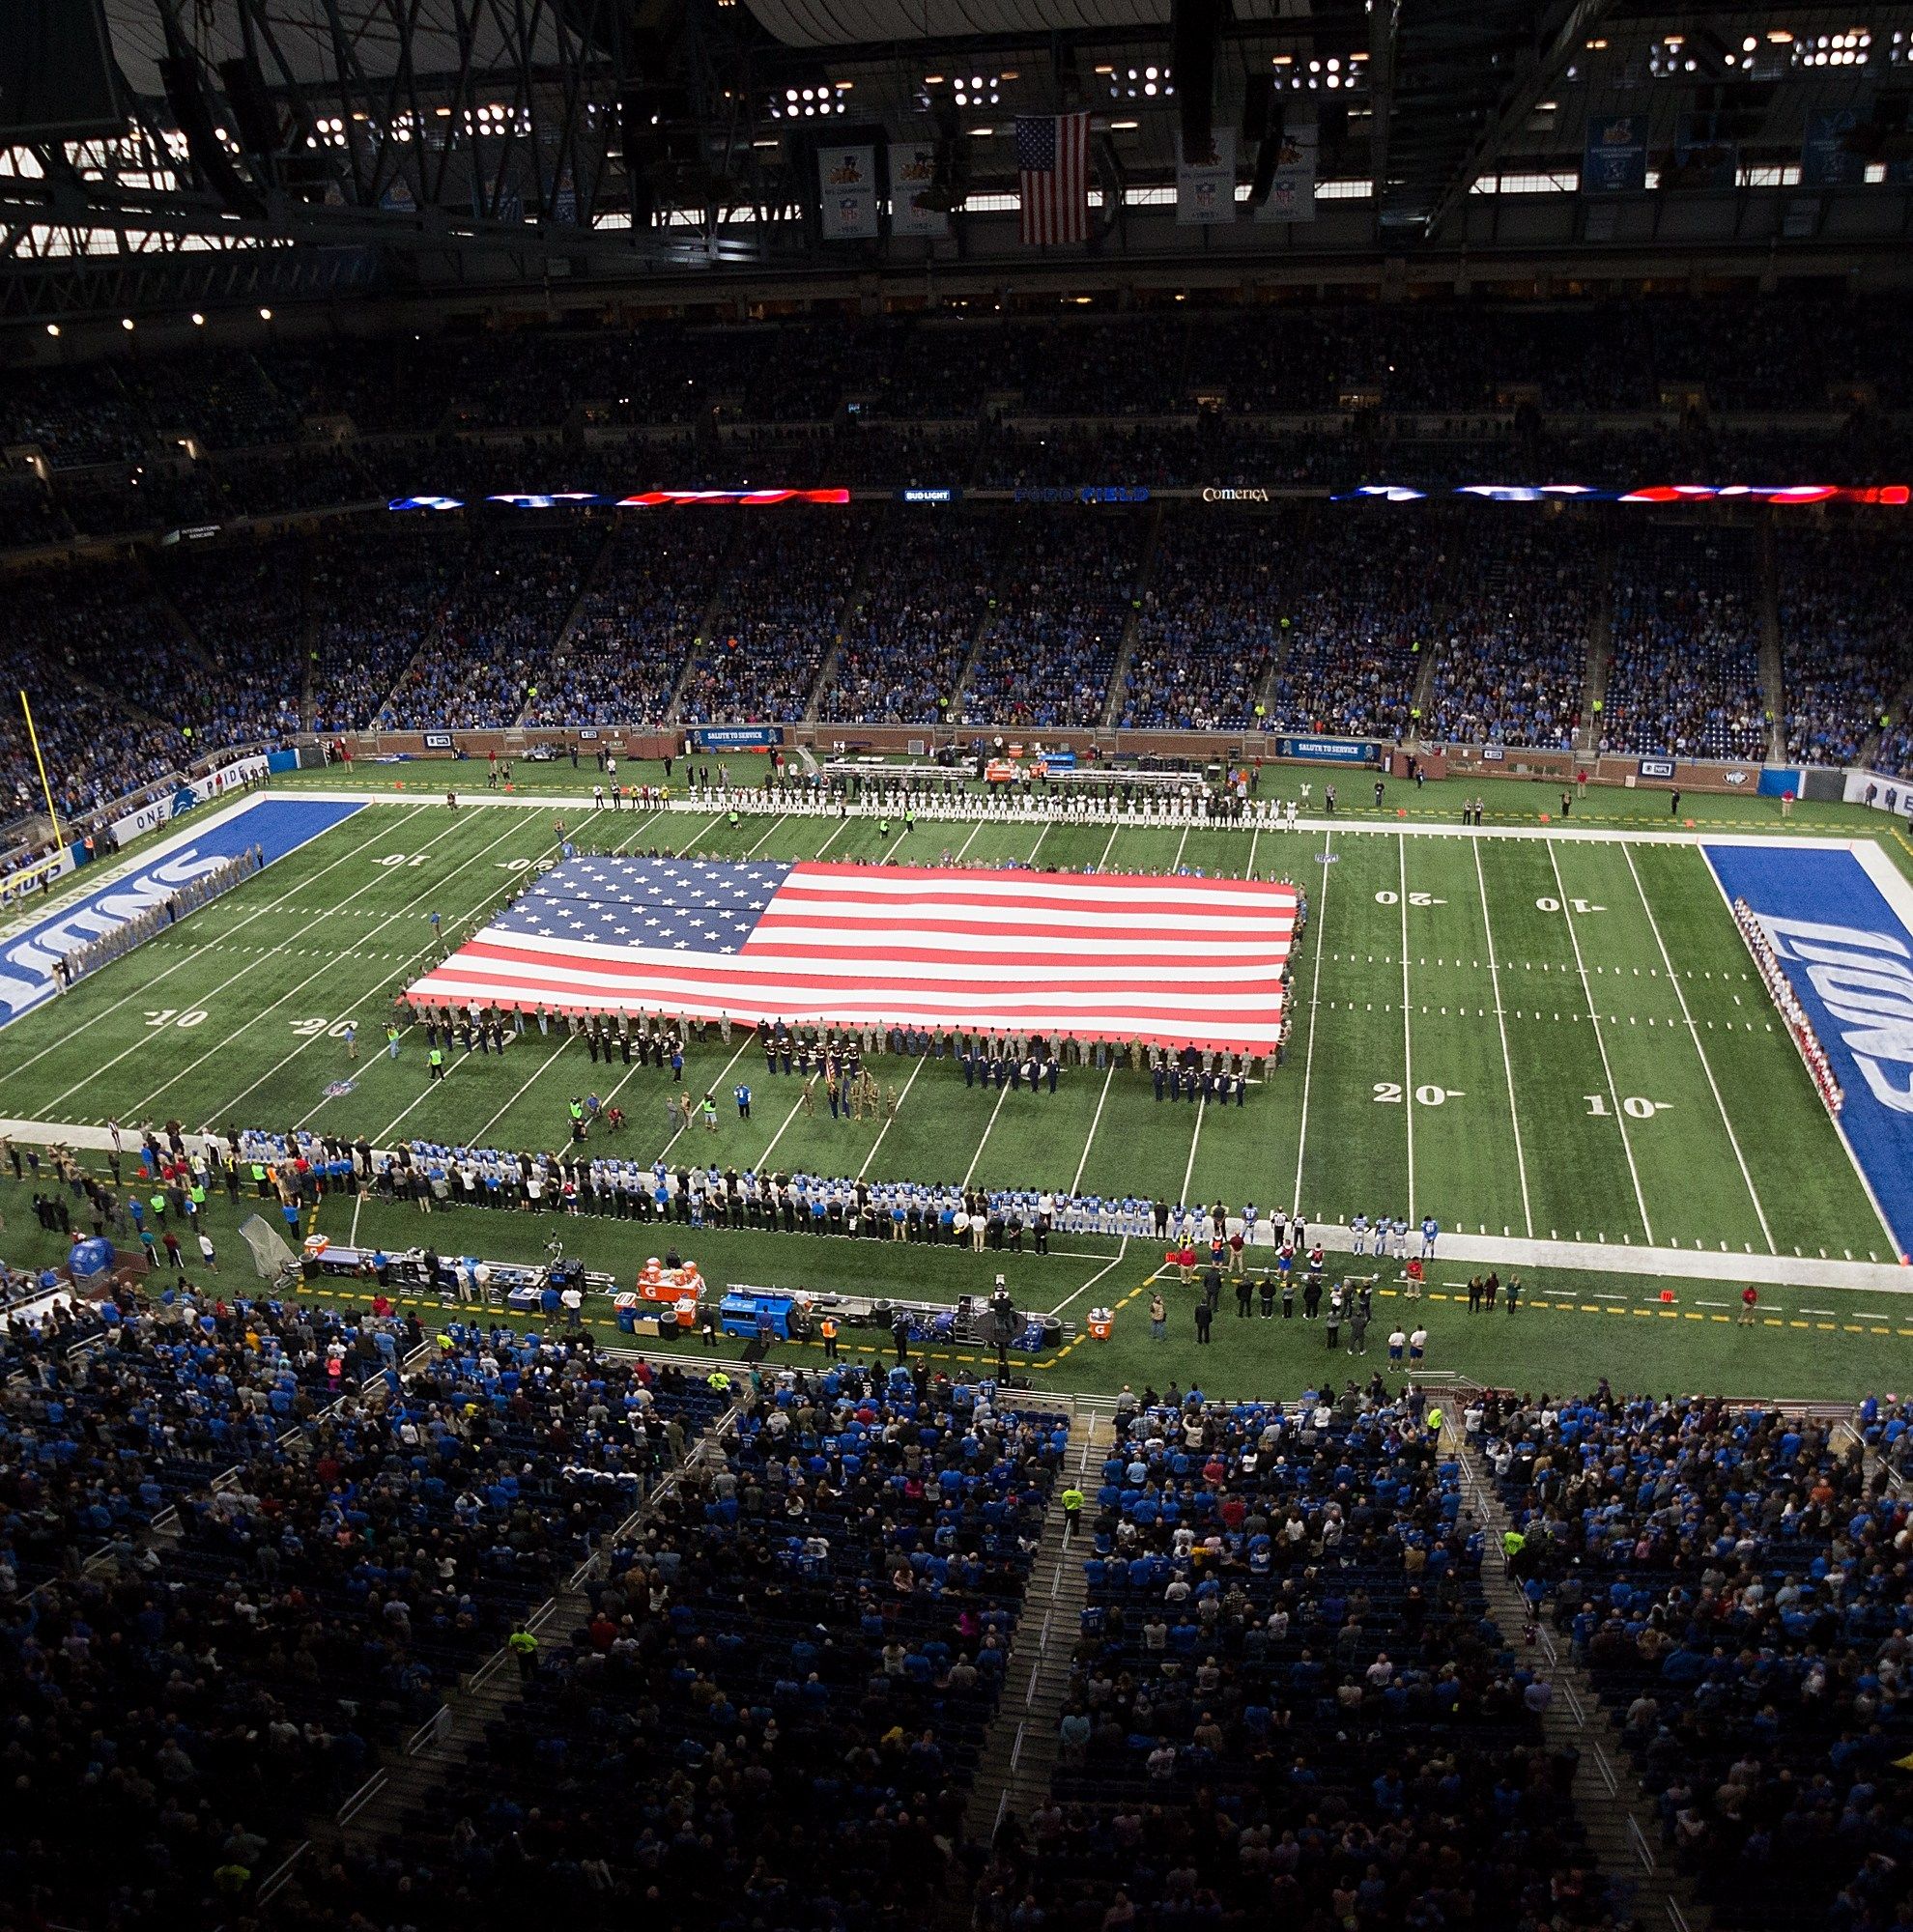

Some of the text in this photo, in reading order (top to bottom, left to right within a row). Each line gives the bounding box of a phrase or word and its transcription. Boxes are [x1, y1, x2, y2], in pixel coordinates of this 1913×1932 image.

[906, 491, 949, 500] BUD LIGHT
[1014, 487, 1150, 502] FORD FIELD
[1298, 743, 1323, 752] SALUTE
[1331, 746, 1358, 754] SERVICE
[136, 764, 246, 829] ONE PIDE
[145, 1009, 208, 1027] 10
[1373, 1083, 1655, 1119] 20 10
[644, 1287, 656, 1297] G
[1094, 1325, 1105, 1335] G
